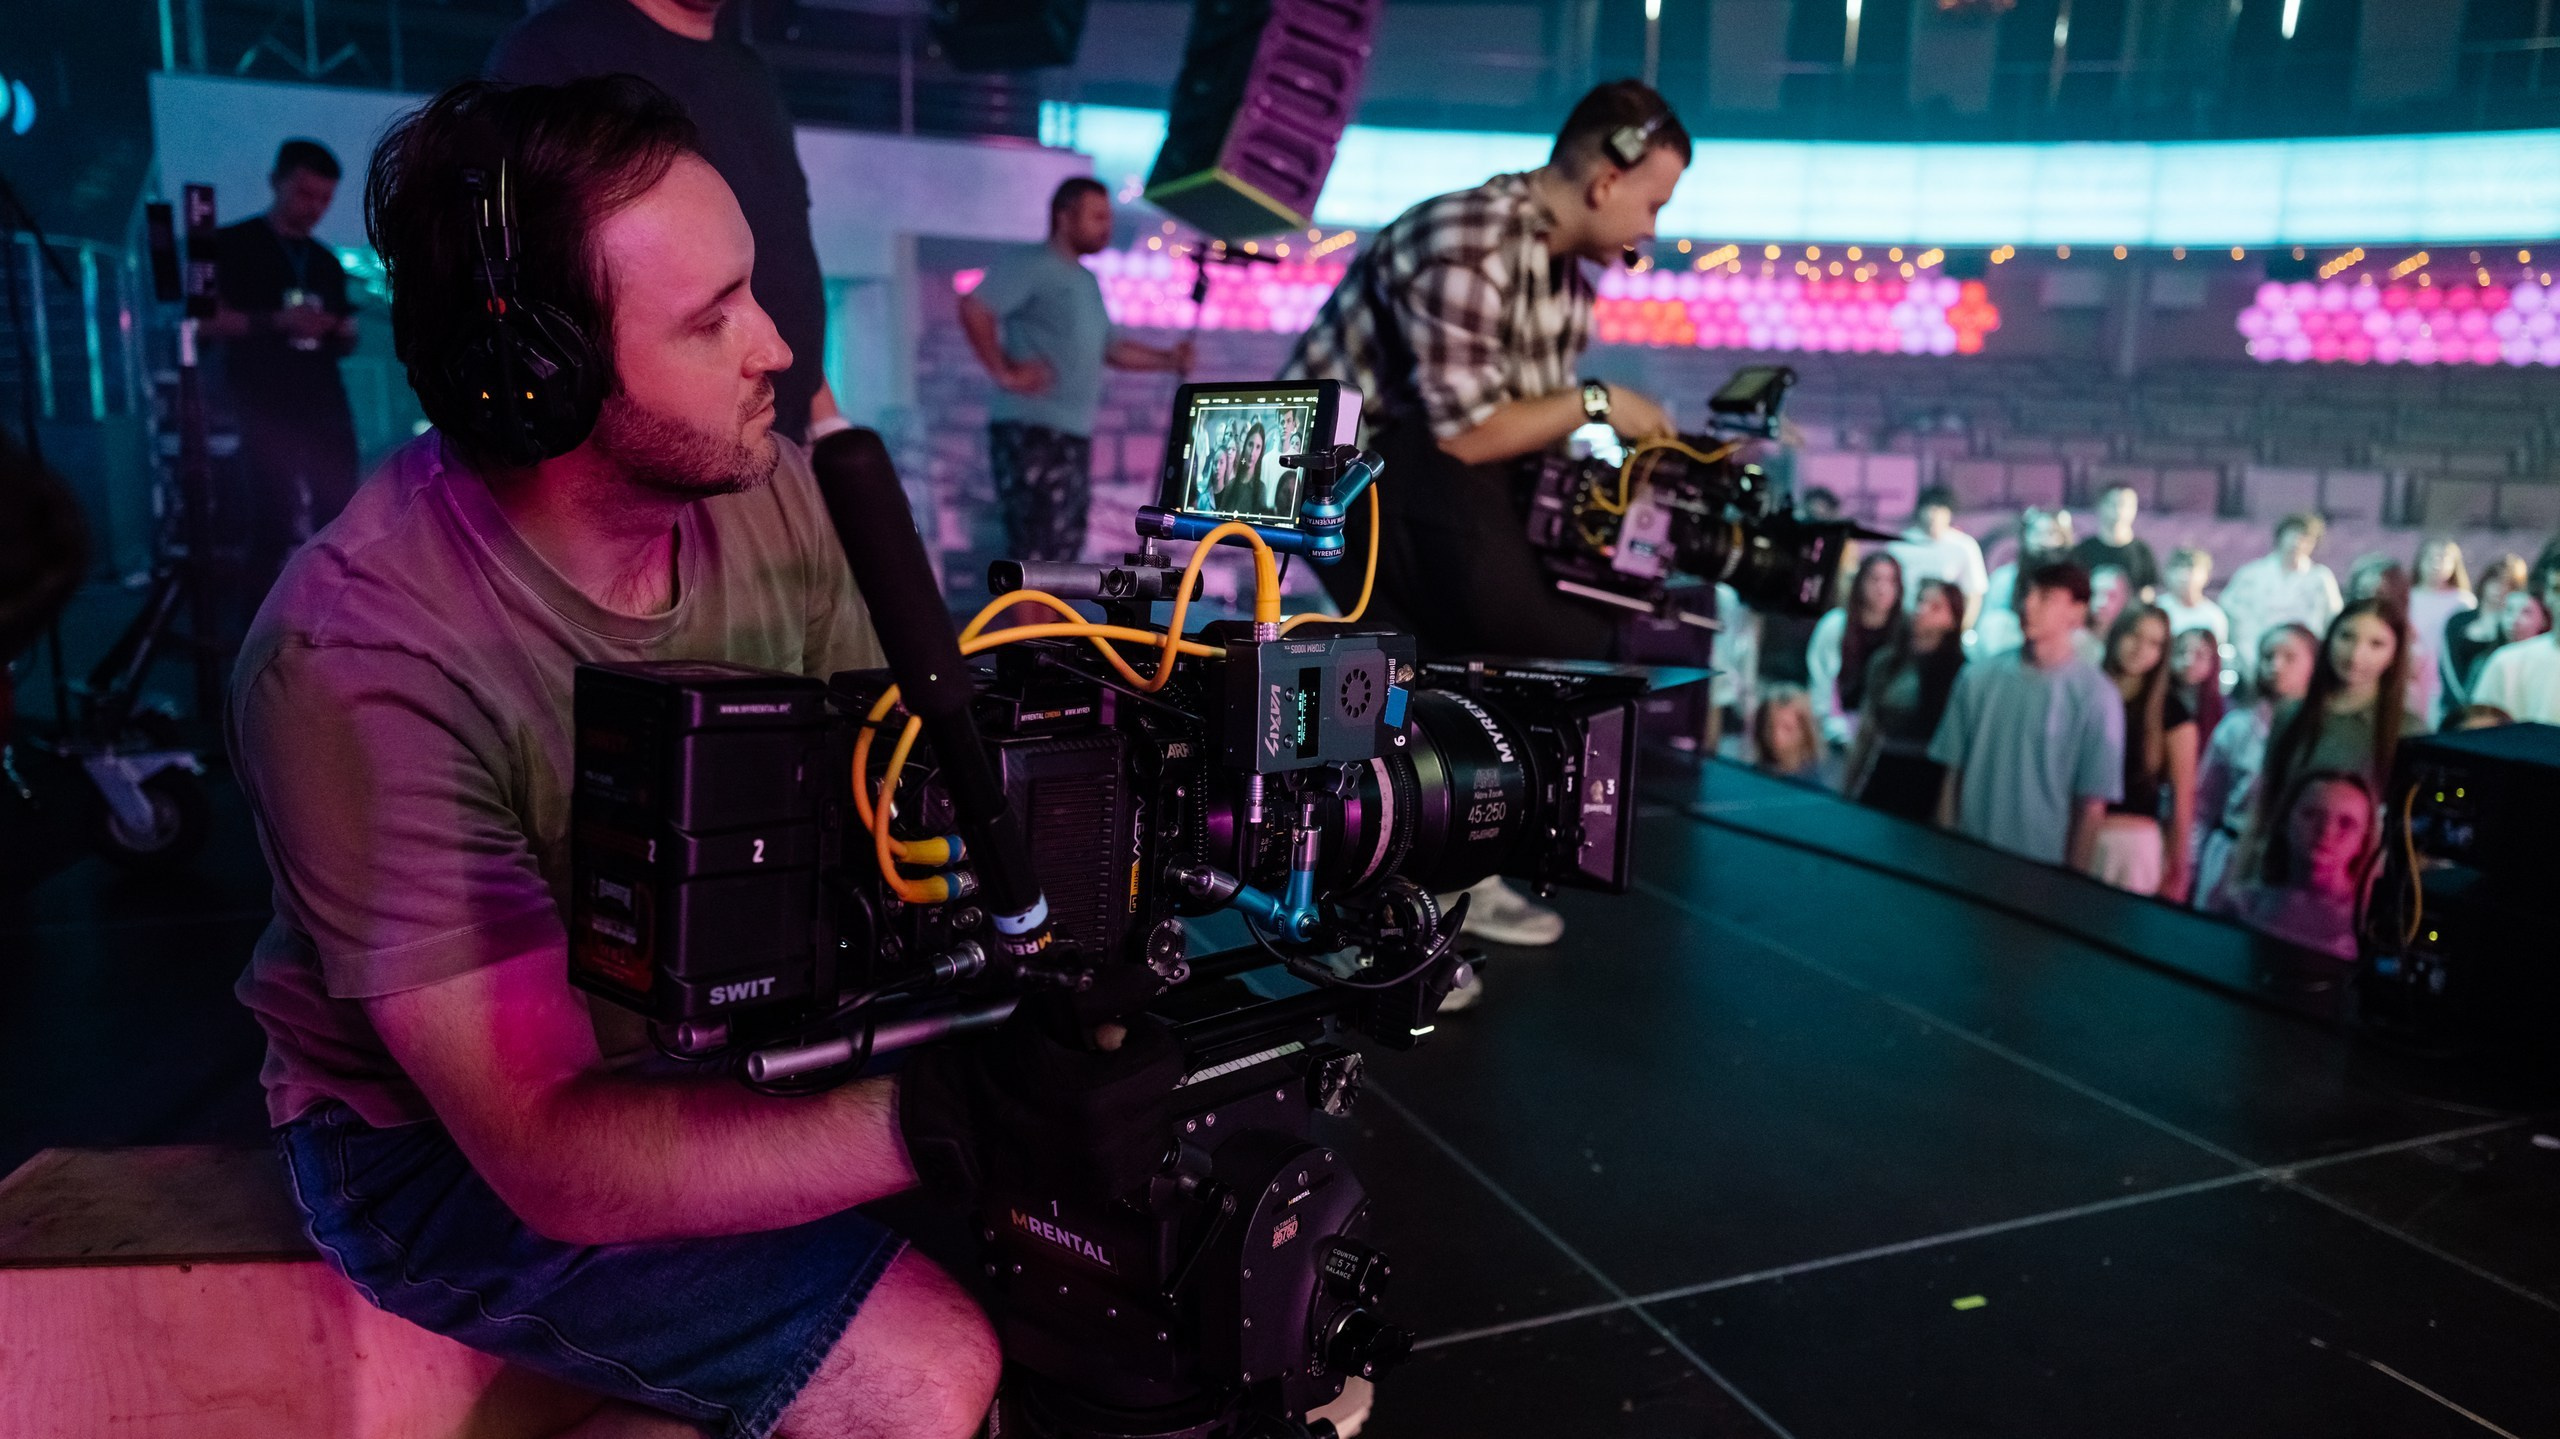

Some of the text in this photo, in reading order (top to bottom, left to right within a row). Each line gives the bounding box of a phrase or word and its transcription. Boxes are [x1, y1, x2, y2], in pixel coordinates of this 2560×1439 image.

[1312, 549, 1341, 557] MYRENTAL
[1307, 643, 1326, 653] STORM
[1264, 684, 1282, 758] VAXIS
[1606, 779, 1615, 795] 3
[1468, 802, 1507, 824] 45-250
[752, 838, 765, 863] 2
[709, 976, 776, 1006] SWIT
[1051, 1200, 1058, 1217] 1
[1010, 1208, 1111, 1266] MRENTAL
[1333, 1248, 1359, 1262] COUNTER
[1325, 1264, 1351, 1280] BALANCE
